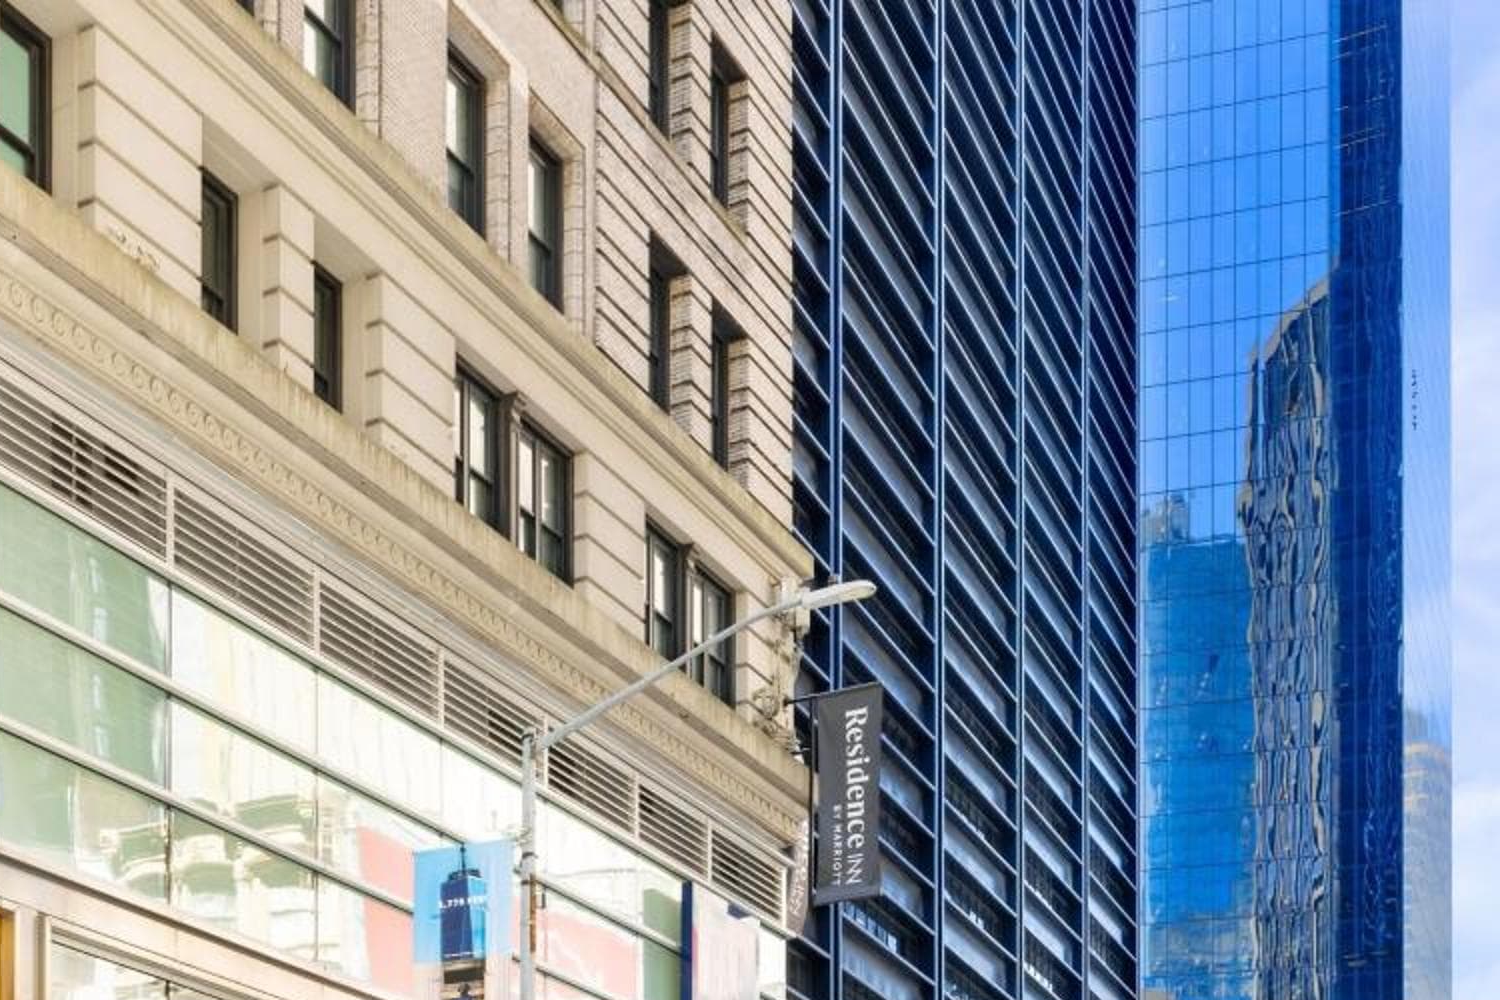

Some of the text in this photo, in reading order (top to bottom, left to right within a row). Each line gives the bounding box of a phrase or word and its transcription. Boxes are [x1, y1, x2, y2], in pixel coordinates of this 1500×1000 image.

[831, 824, 844, 886] MARRIOTT
[845, 705, 871, 885] Residence INN
